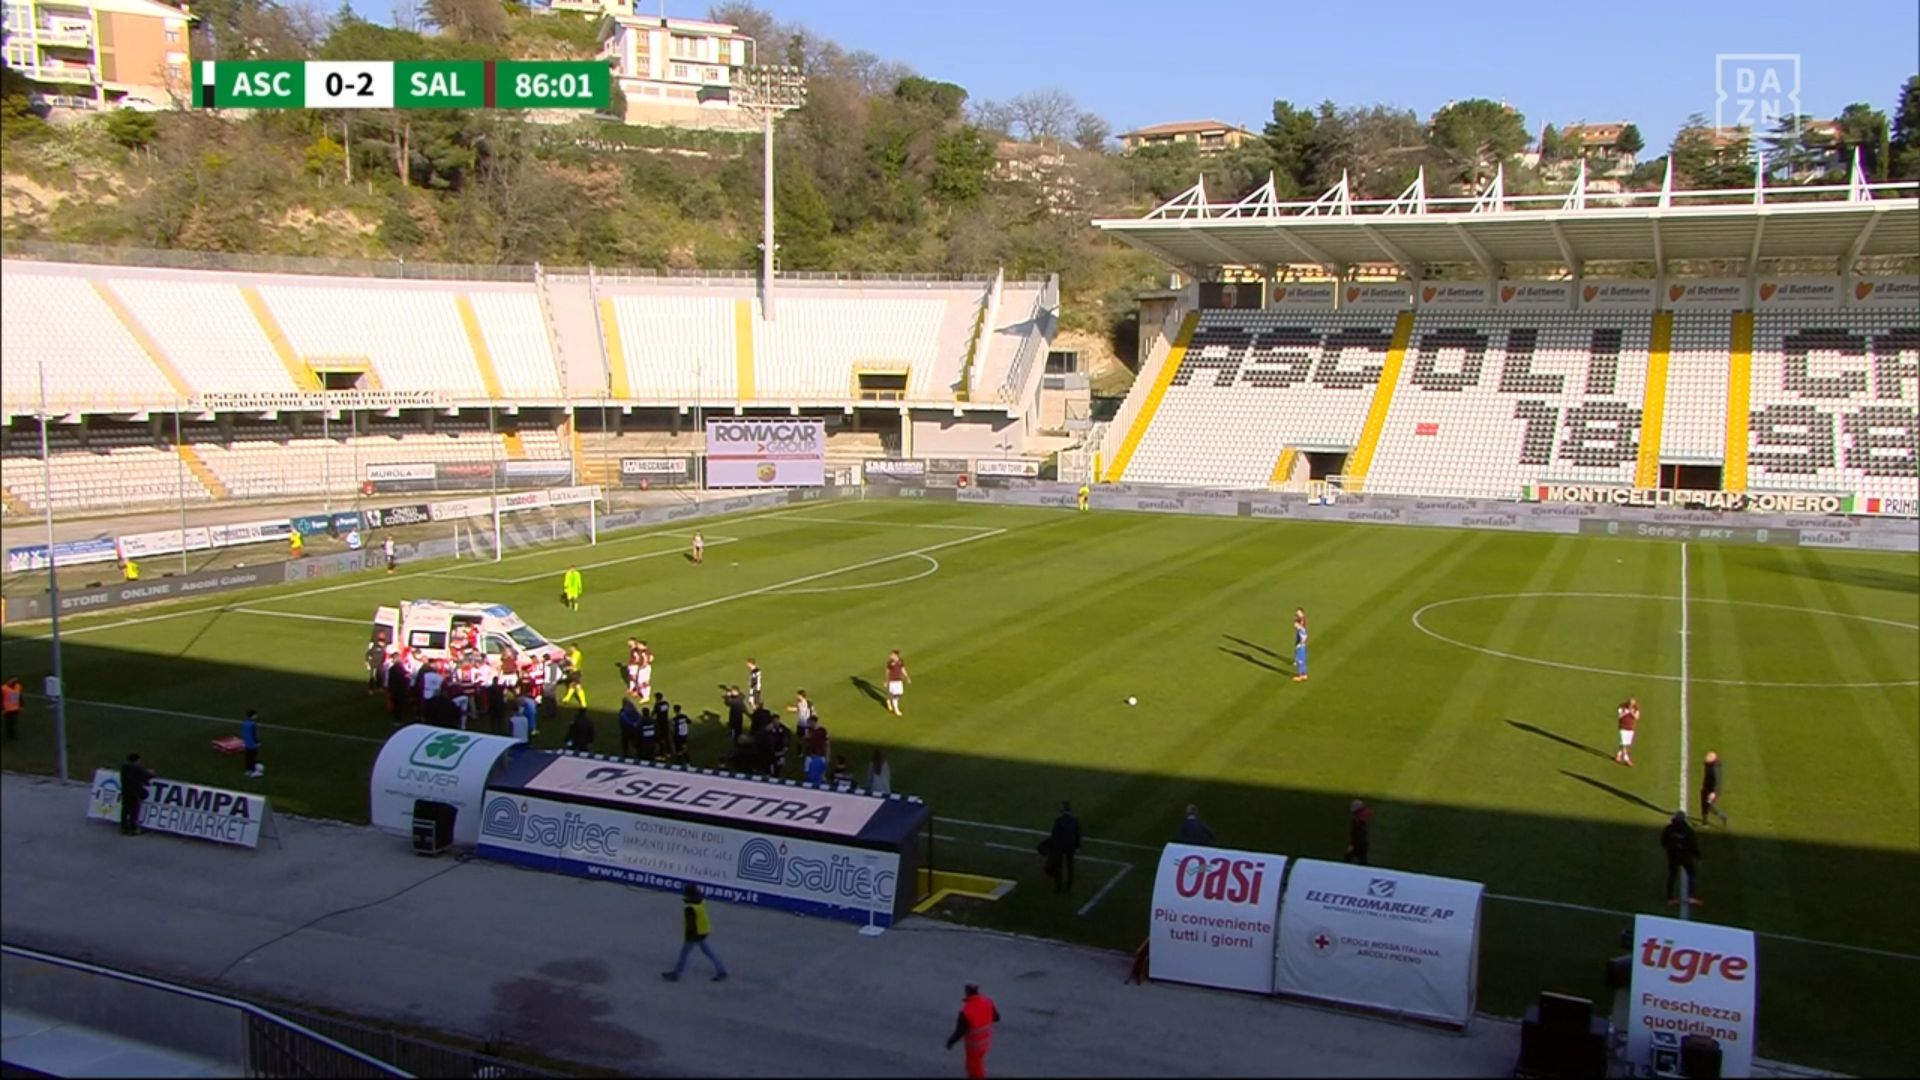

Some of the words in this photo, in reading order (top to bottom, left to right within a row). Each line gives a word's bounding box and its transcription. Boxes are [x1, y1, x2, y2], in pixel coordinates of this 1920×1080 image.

[1170, 327, 1622, 392] ASCOLI
[715, 424, 817, 442] ROMACAR
[766, 441, 817, 453] GROUP
[1549, 486, 1674, 506] MONTICELLI
[1638, 522, 1675, 537] Serie
[62, 593, 109, 609] STORE
[121, 584, 170, 600] ONLINE
[181, 577, 218, 592] Ascoli
[220, 573, 257, 586] Calcio
[614, 780, 832, 825] SELETTRA
[524, 811, 621, 857] saitec
[634, 820, 698, 839] COSTRUZIONI
[701, 831, 725, 845] EDILI
[785, 854, 896, 903] saitec
[1305, 889, 1431, 917] ELETTROMARCHE
[1431, 908, 1455, 920] AP
[1155, 908, 1178, 923] Più
[1181, 913, 1272, 934] conveniente
[1170, 928, 1199, 942] tutti
[1211, 933, 1253, 948] giorni
[1340, 936, 1369, 948] CROCE
[1371, 940, 1401, 951] ROSSA
[1401, 944, 1440, 957] ITALIANA
[1357, 949, 1388, 960] ASCOLI
[1389, 952, 1422, 965] PICENO
[1642, 938, 1749, 984] tigre
[1642, 993, 1742, 1022] Freschezza
[1643, 1014, 1738, 1041] quotidiana
